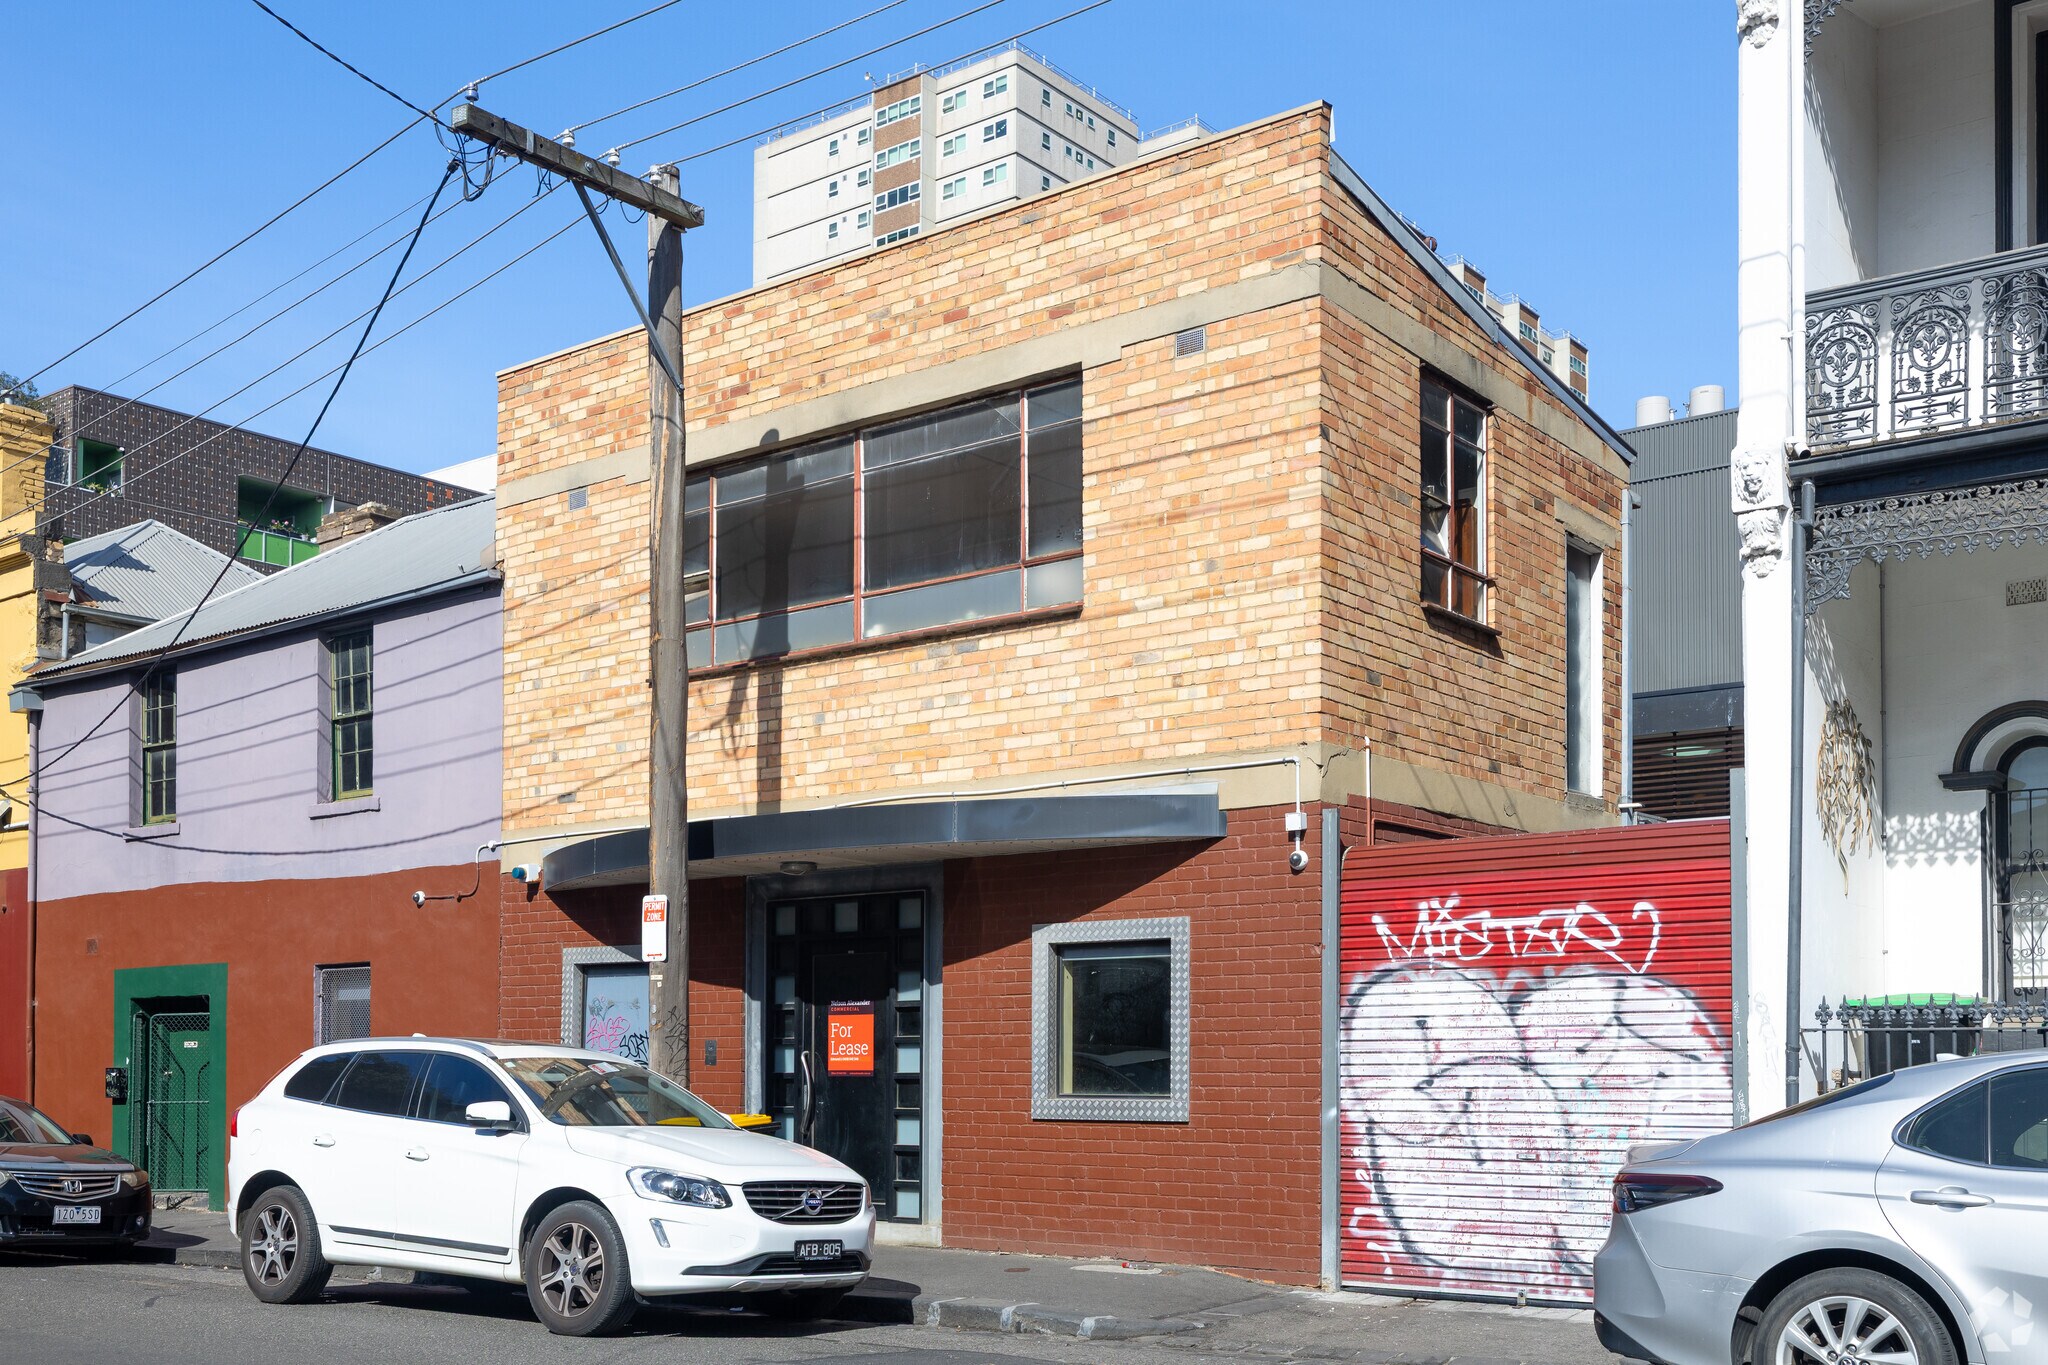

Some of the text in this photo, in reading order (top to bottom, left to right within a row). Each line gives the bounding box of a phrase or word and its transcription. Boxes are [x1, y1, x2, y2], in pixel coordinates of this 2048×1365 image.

[644, 901, 665, 911] PERMIT
[646, 911, 662, 922] ZONE
[830, 1022, 853, 1038] For
[830, 1040, 869, 1056] Lease
